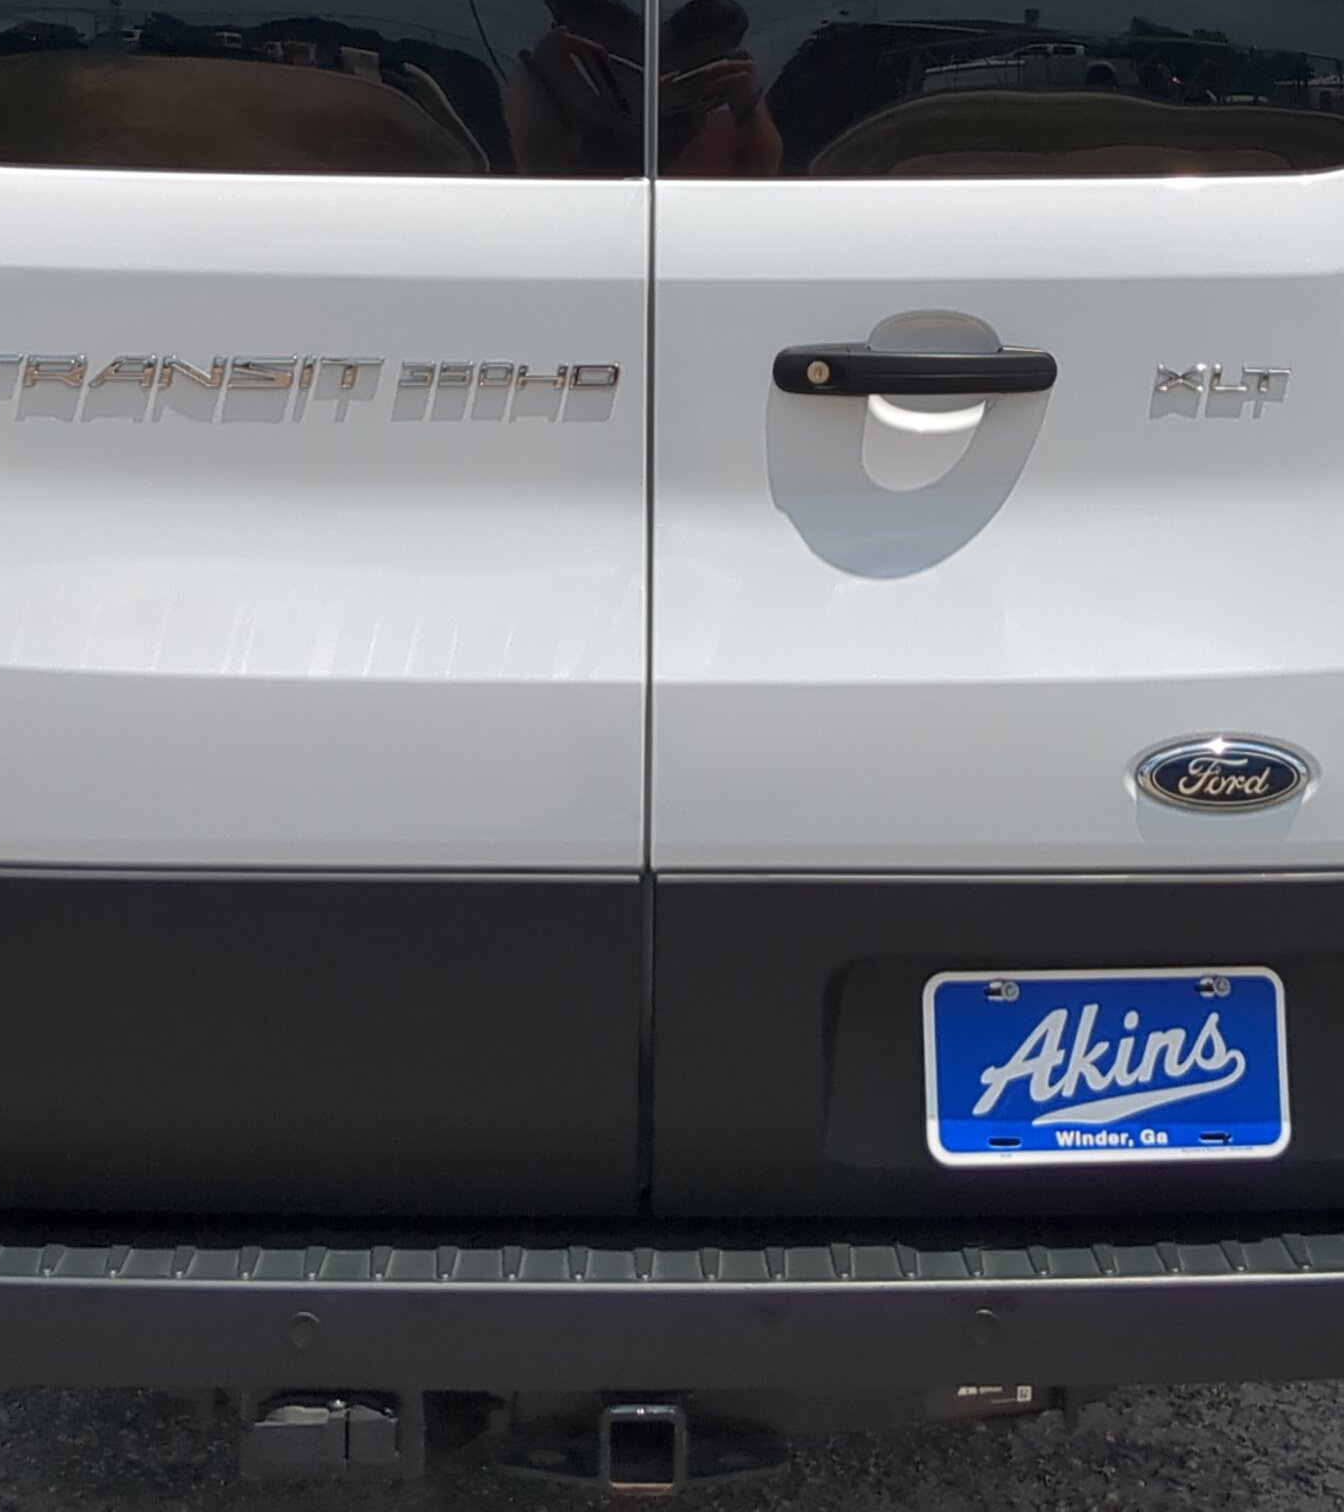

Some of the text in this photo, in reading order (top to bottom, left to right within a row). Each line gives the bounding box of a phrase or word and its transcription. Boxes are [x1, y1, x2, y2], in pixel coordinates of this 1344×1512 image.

[1154, 362, 1292, 392] XLT
[1178, 757, 1271, 795] Ford
[972, 1004, 1246, 1120] Akins
[1056, 1129, 1168, 1148] Winder, Ga
